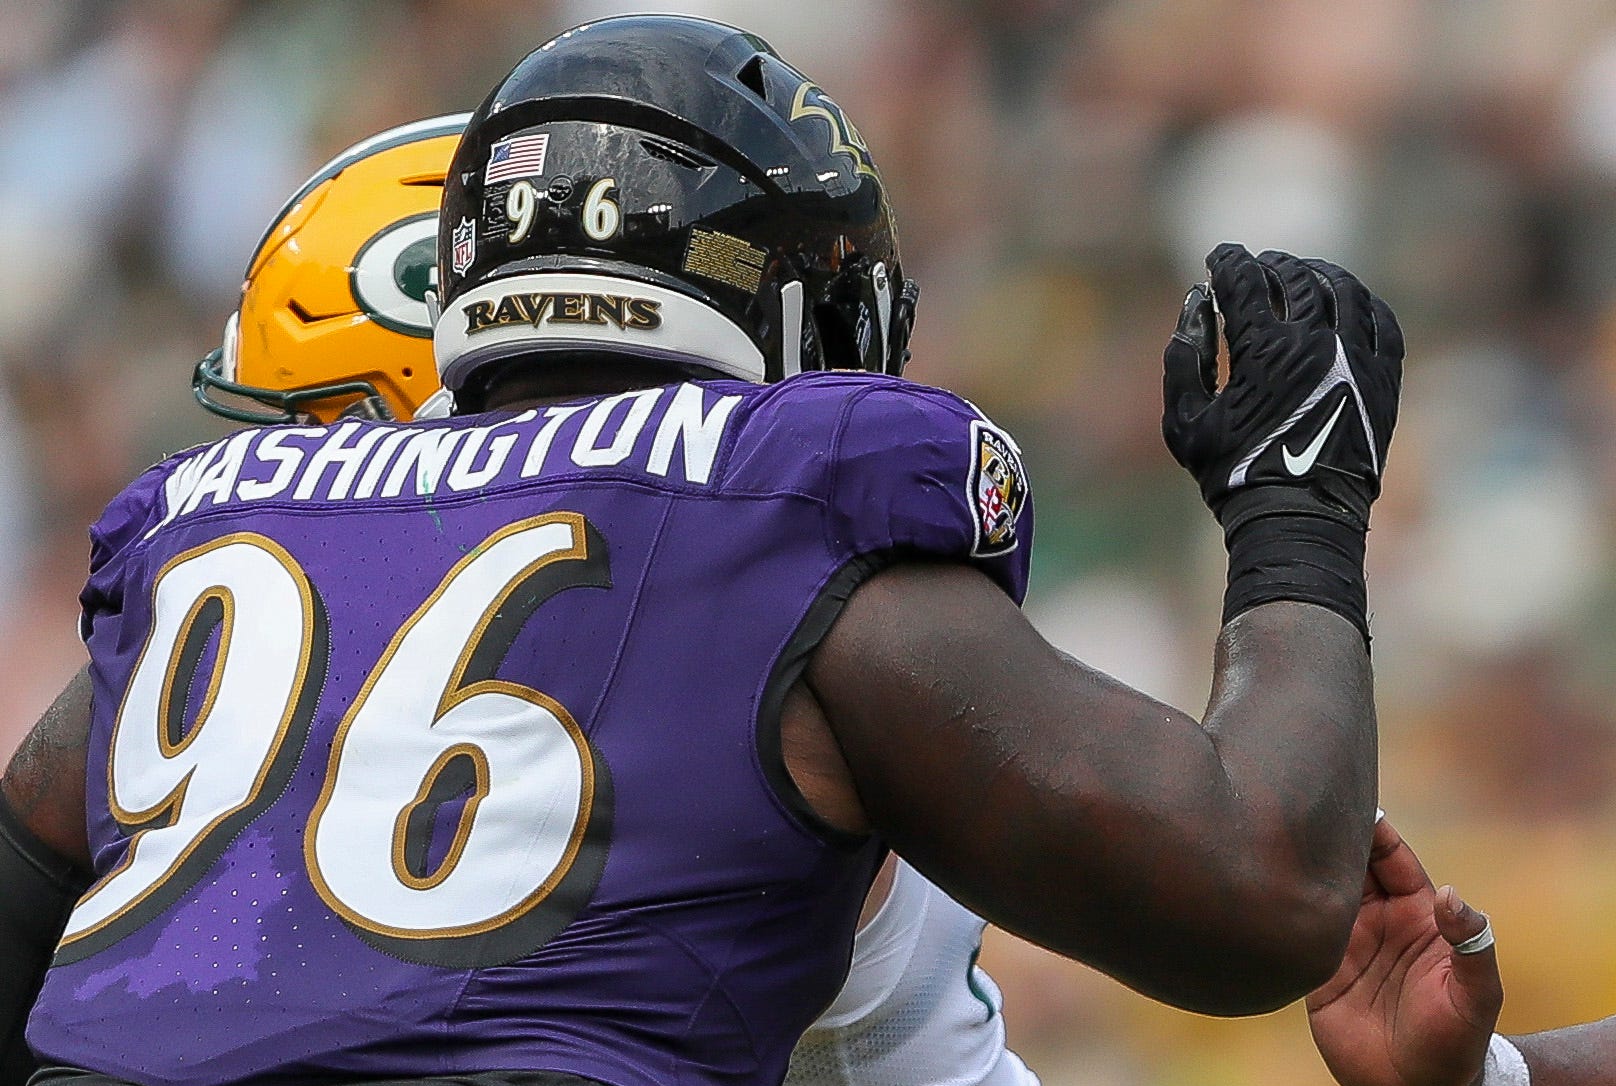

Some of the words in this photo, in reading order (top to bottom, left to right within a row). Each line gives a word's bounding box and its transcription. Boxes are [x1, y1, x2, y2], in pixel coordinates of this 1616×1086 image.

[454, 241, 472, 266] NFL
[462, 292, 662, 338] RAVENS
[145, 383, 743, 540] WASHINGTON
[52, 510, 613, 968] 96
